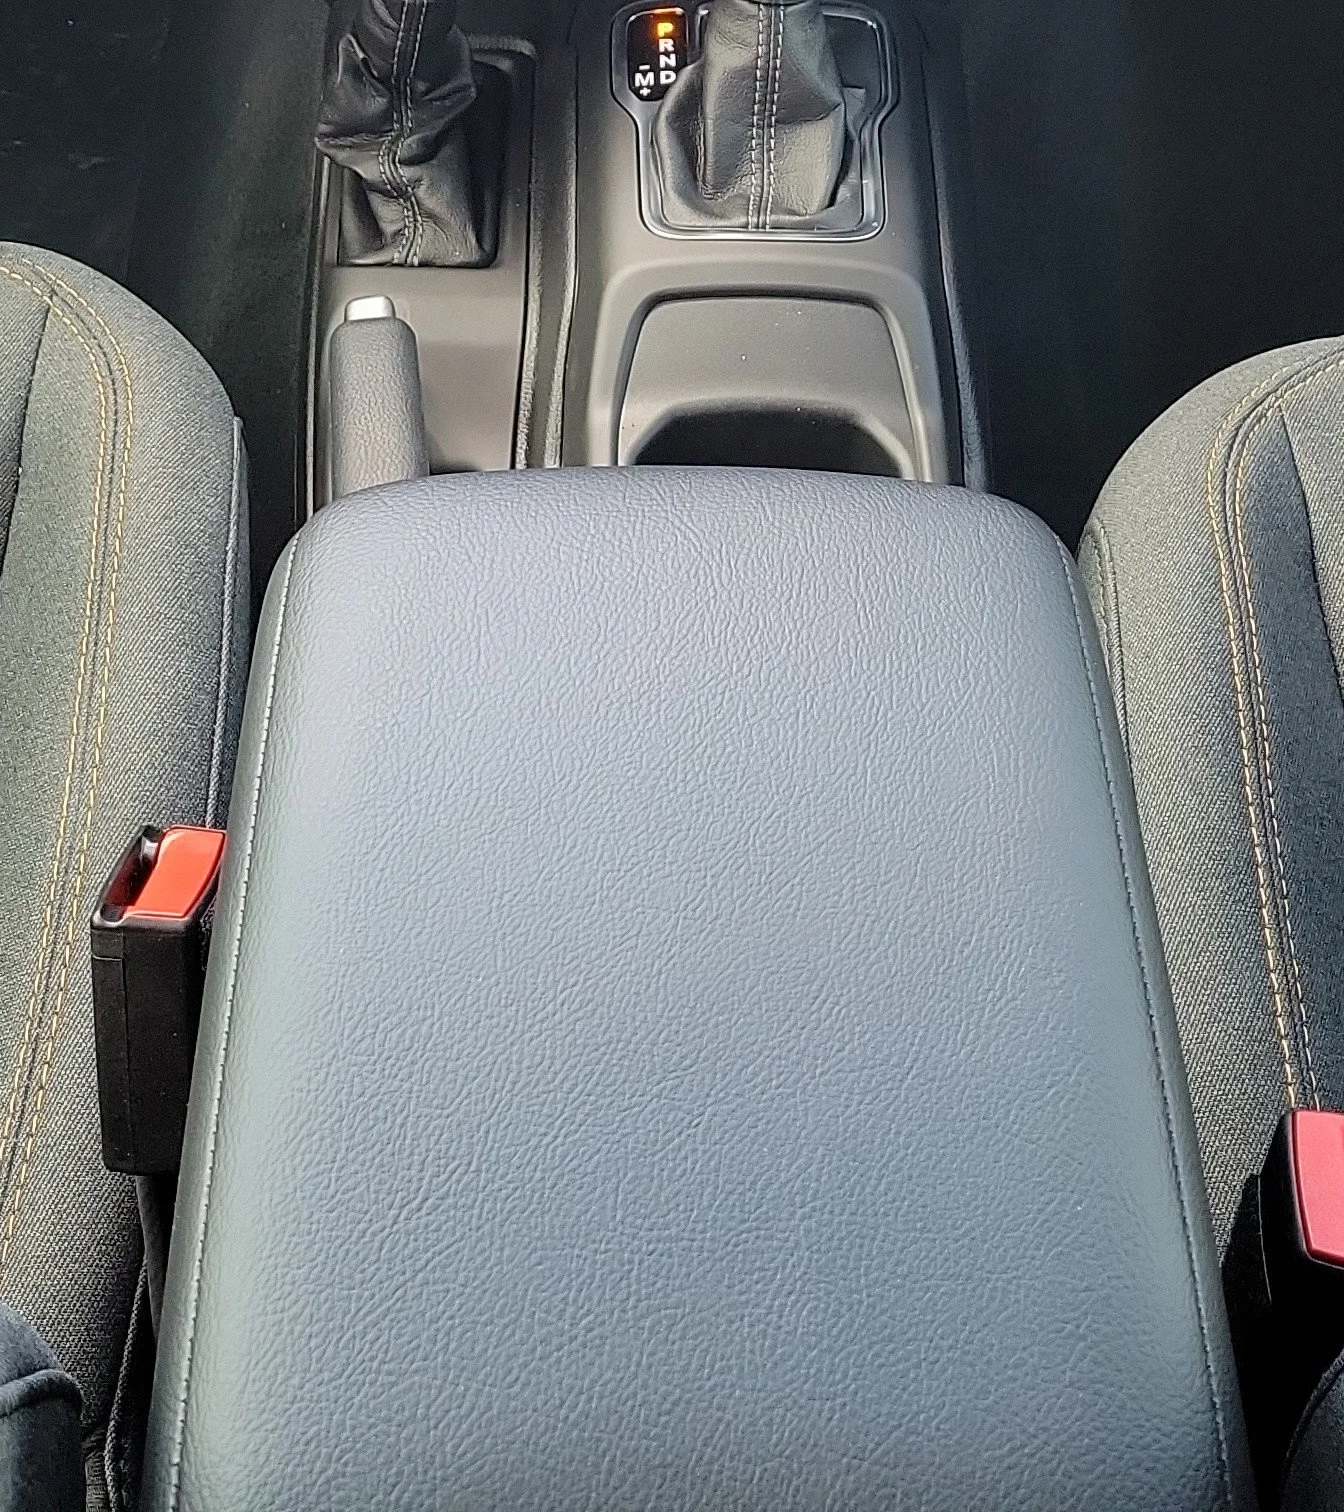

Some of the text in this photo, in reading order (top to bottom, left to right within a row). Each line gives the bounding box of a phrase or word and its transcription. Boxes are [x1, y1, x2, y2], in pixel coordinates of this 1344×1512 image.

[657, 22, 674, 38] P
[658, 38, 675, 53] R
[659, 53, 676, 68] N
[634, 71, 655, 87] M
[659, 70, 677, 85] D
